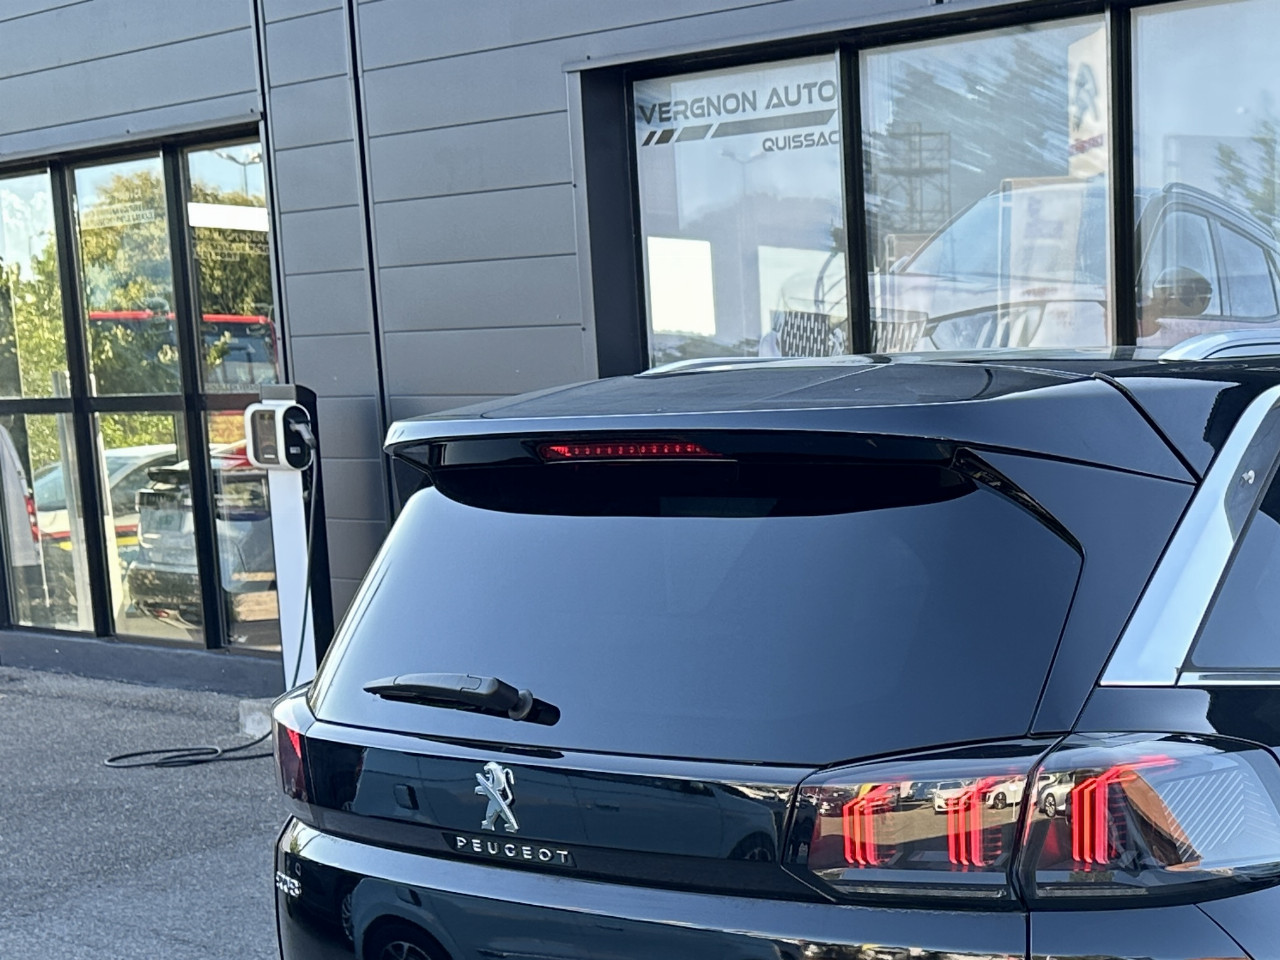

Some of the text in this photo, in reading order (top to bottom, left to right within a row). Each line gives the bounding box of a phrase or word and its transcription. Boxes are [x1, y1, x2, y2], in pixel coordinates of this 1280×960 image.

[638, 80, 838, 125] VERGNON AUTO
[762, 130, 840, 152] QUISSAC
[456, 836, 568, 863] PEUGEOT
